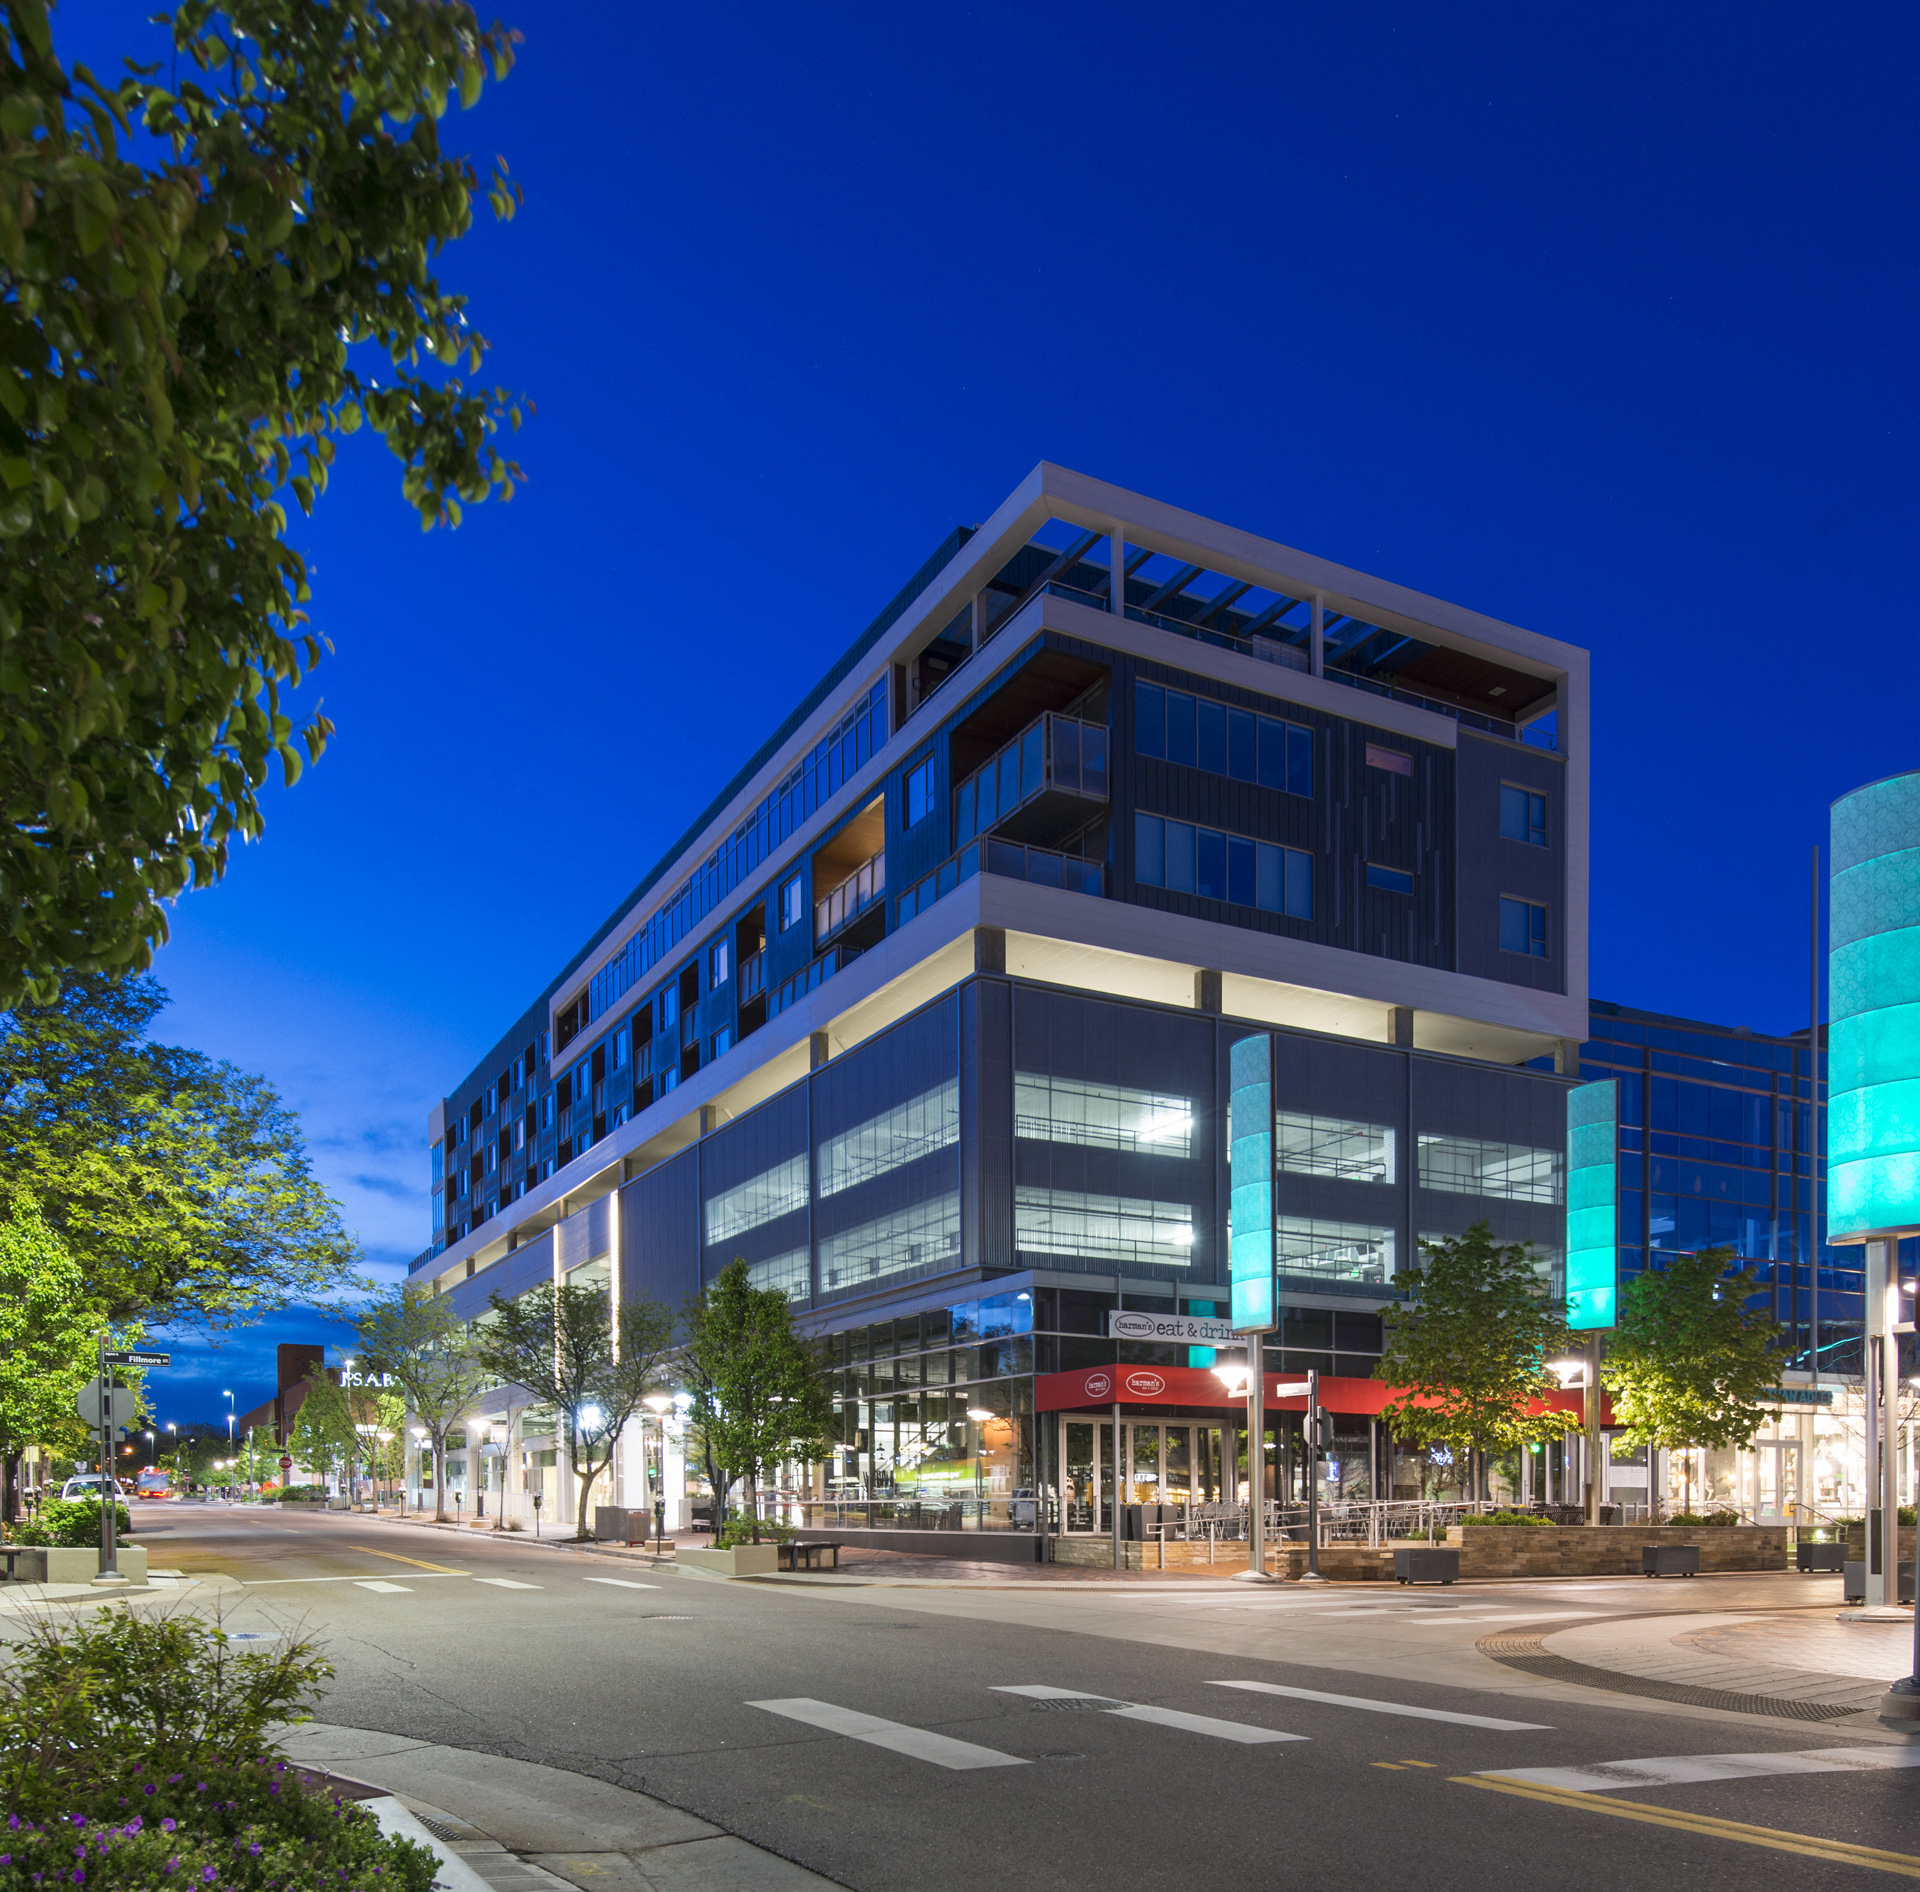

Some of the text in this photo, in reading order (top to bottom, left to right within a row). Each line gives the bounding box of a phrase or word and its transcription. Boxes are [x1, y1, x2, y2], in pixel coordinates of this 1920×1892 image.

[1118, 1321, 1153, 1331] harman's
[1156, 1320, 1246, 1341] eat & drin
[128, 1355, 162, 1365] Fillmore
[1131, 1378, 1160, 1388] harman's
